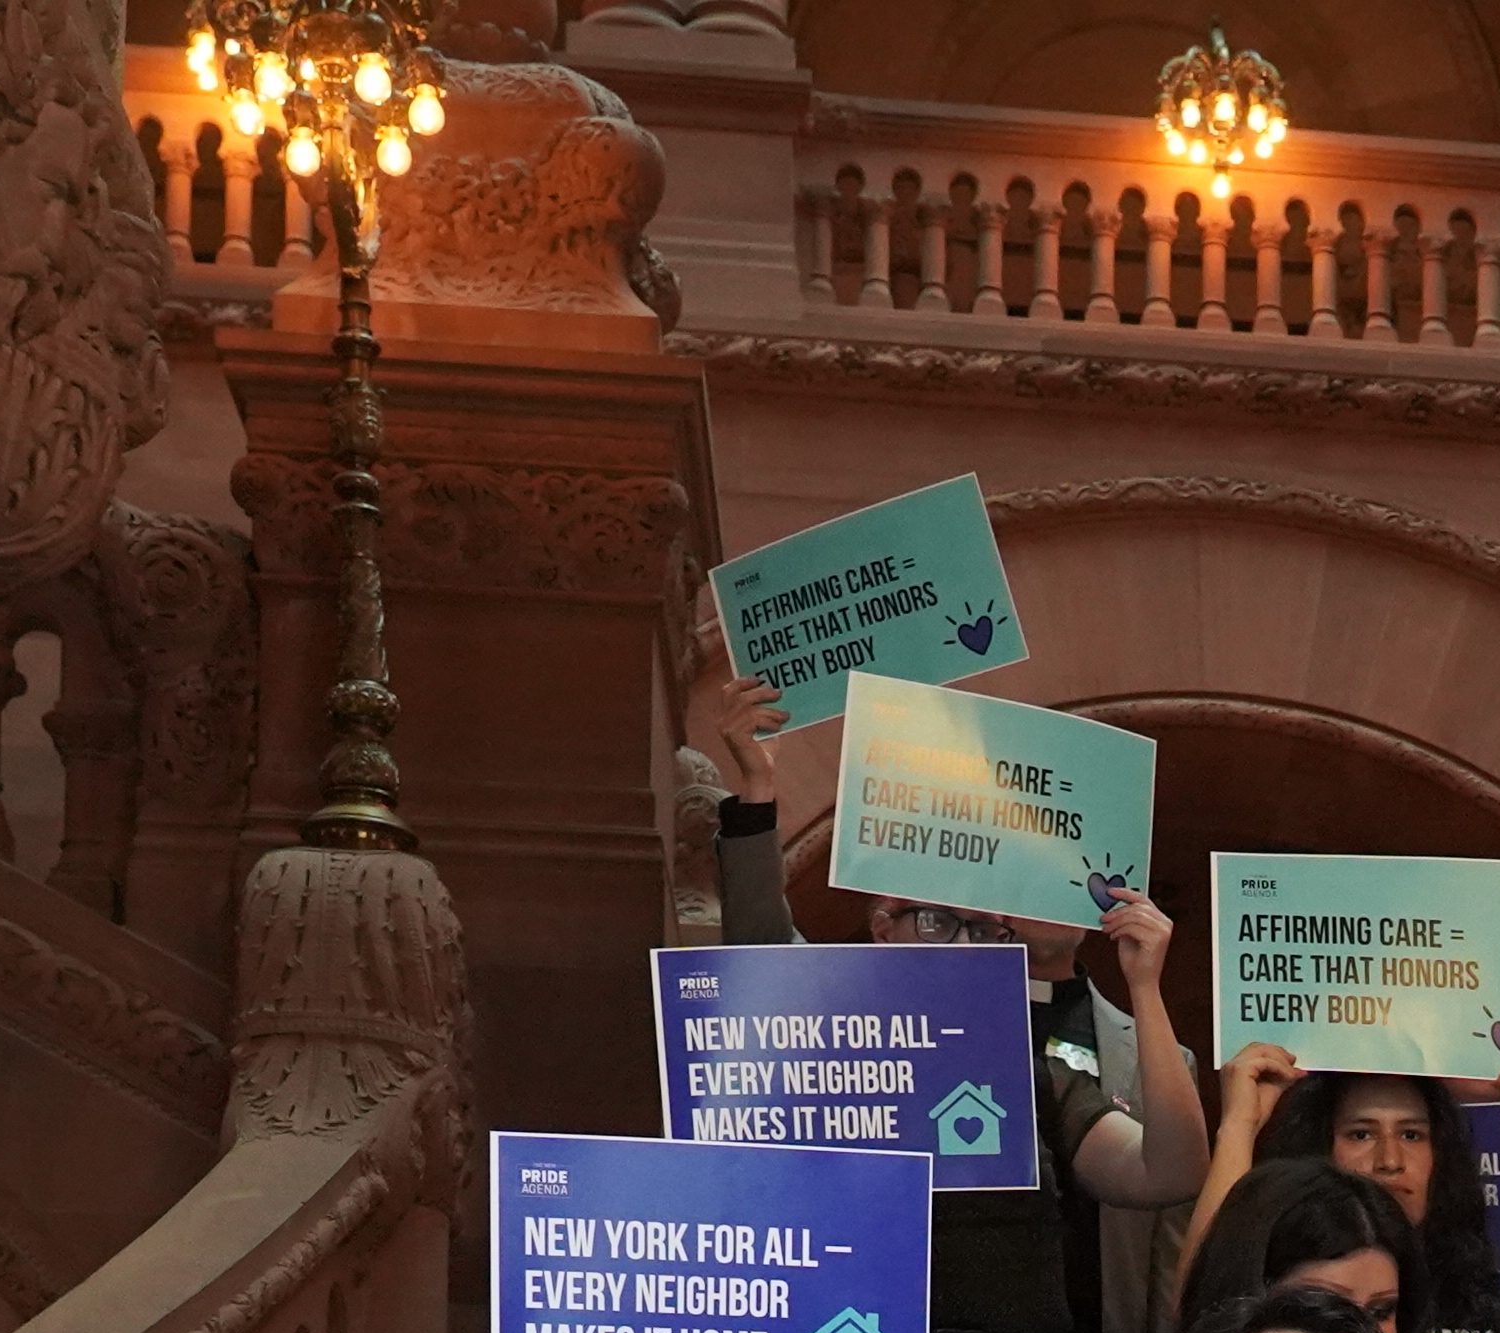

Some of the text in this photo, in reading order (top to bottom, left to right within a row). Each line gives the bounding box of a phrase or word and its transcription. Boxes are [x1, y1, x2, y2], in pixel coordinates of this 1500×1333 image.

[734, 572, 761, 589] PRIDE
[740, 556, 899, 633] AFFIRMING CARE
[747, 581, 938, 664] CARE THAT HONORS
[824, 636, 876, 675] BODY
[996, 760, 1054, 796] CARE
[862, 777, 1083, 840] CARE THAT HONORS
[858, 816, 1000, 865] EVERY BODY
[1241, 879, 1277, 889] PRIDE
[1238, 914, 1442, 948] AFFIRMING CARE
[679, 976, 719, 990] PRIDE
[1239, 953, 1479, 990] CARE THAT HONORS
[680, 988, 720, 999] AGENDA
[1240, 993, 1392, 1026] EVERY BODY
[685, 1015, 936, 1052] NEW YORK FOR ALL
[688, 1060, 915, 1097] EVERY NEIGHBOR
[691, 1105, 899, 1142] MAKES IT HOME
[521, 1169, 568, 1184] PRIDE
[521, 1183, 568, 1196] AGENDA
[524, 1217, 818, 1267] NEW YORK FOR ALL
[525, 1270, 789, 1318] EVERY NEIGHBOR
